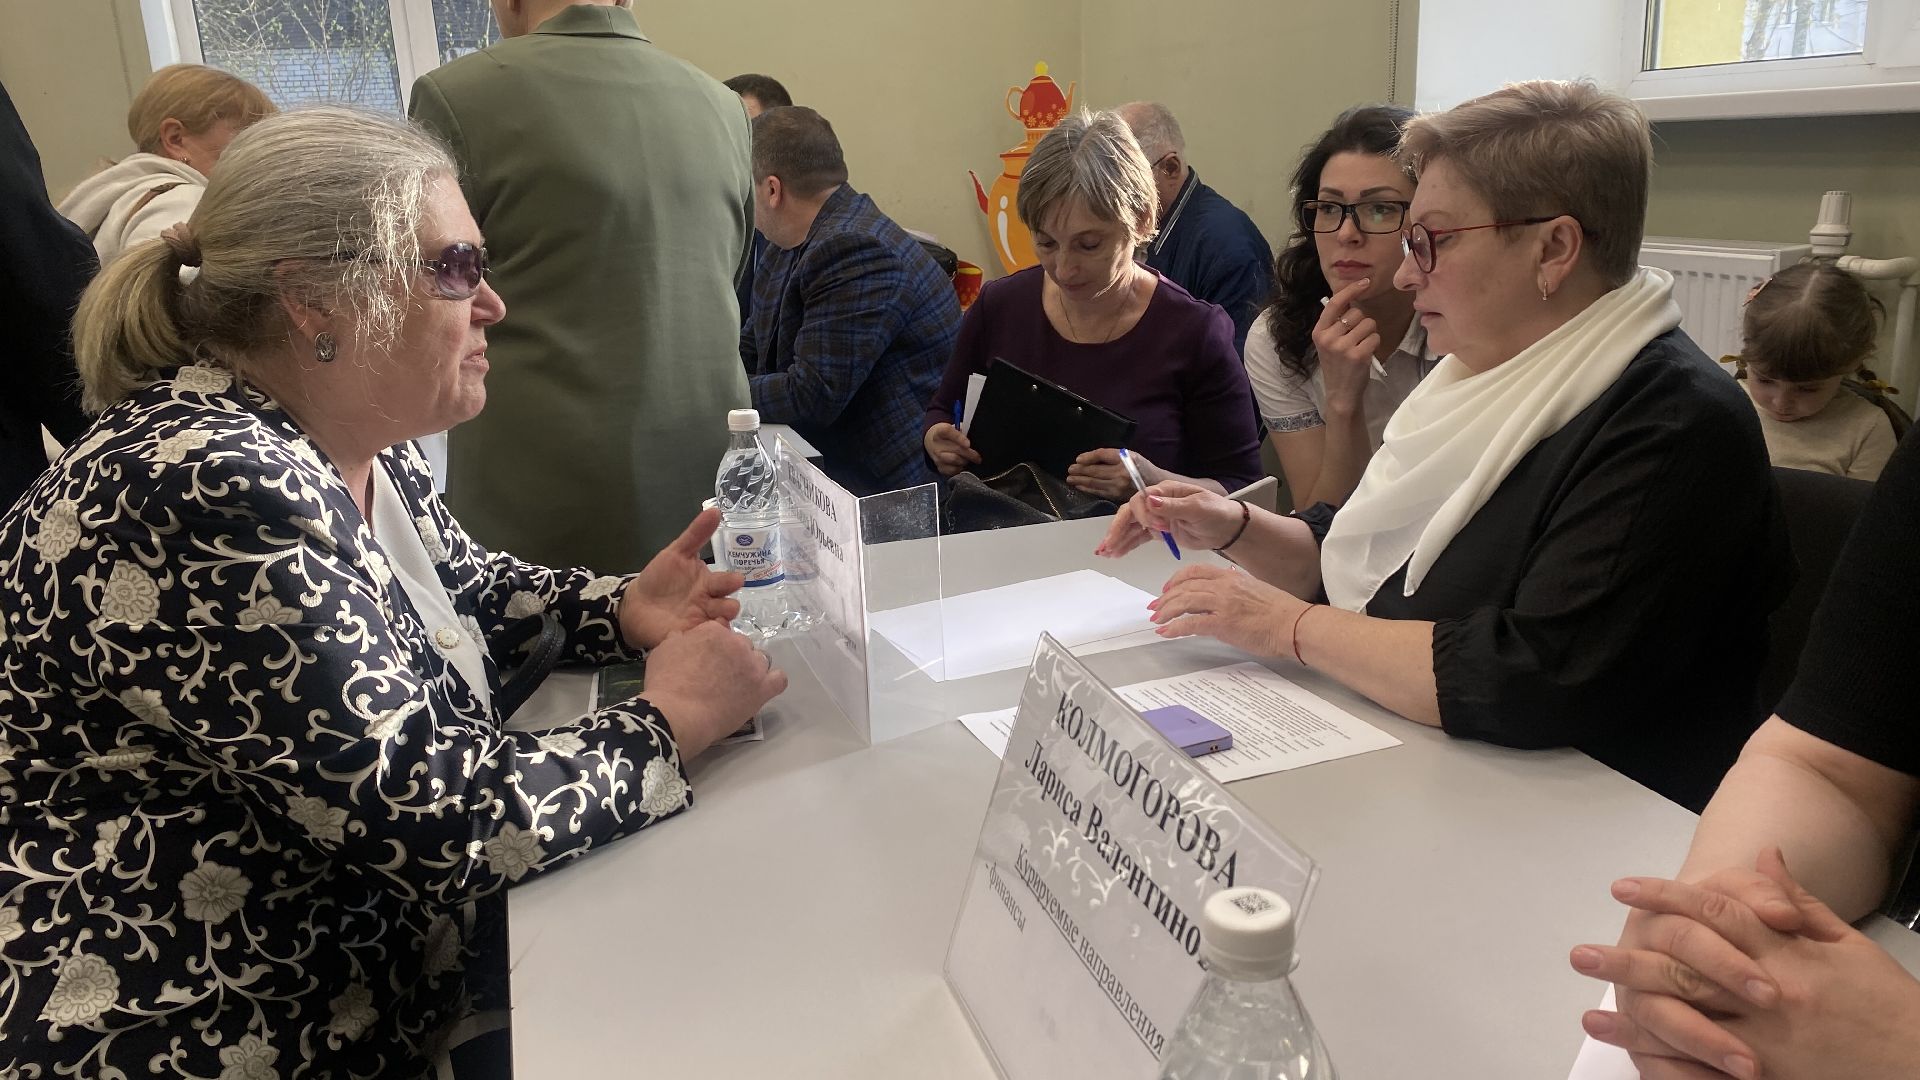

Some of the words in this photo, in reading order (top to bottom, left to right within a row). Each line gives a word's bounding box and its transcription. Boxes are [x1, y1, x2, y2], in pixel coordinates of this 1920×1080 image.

[733, 558, 765, 566] ПОРЕЧЬЯ
[1025, 740, 1081, 826] Лариса
[1084, 803, 1209, 971] Валентино
[1056, 691, 1238, 888] КОЛМОГОРОВА
[989, 861, 1026, 935] финансы
[1015, 843, 1079, 944] Курируемые
[1079, 936, 1165, 1055] направления
